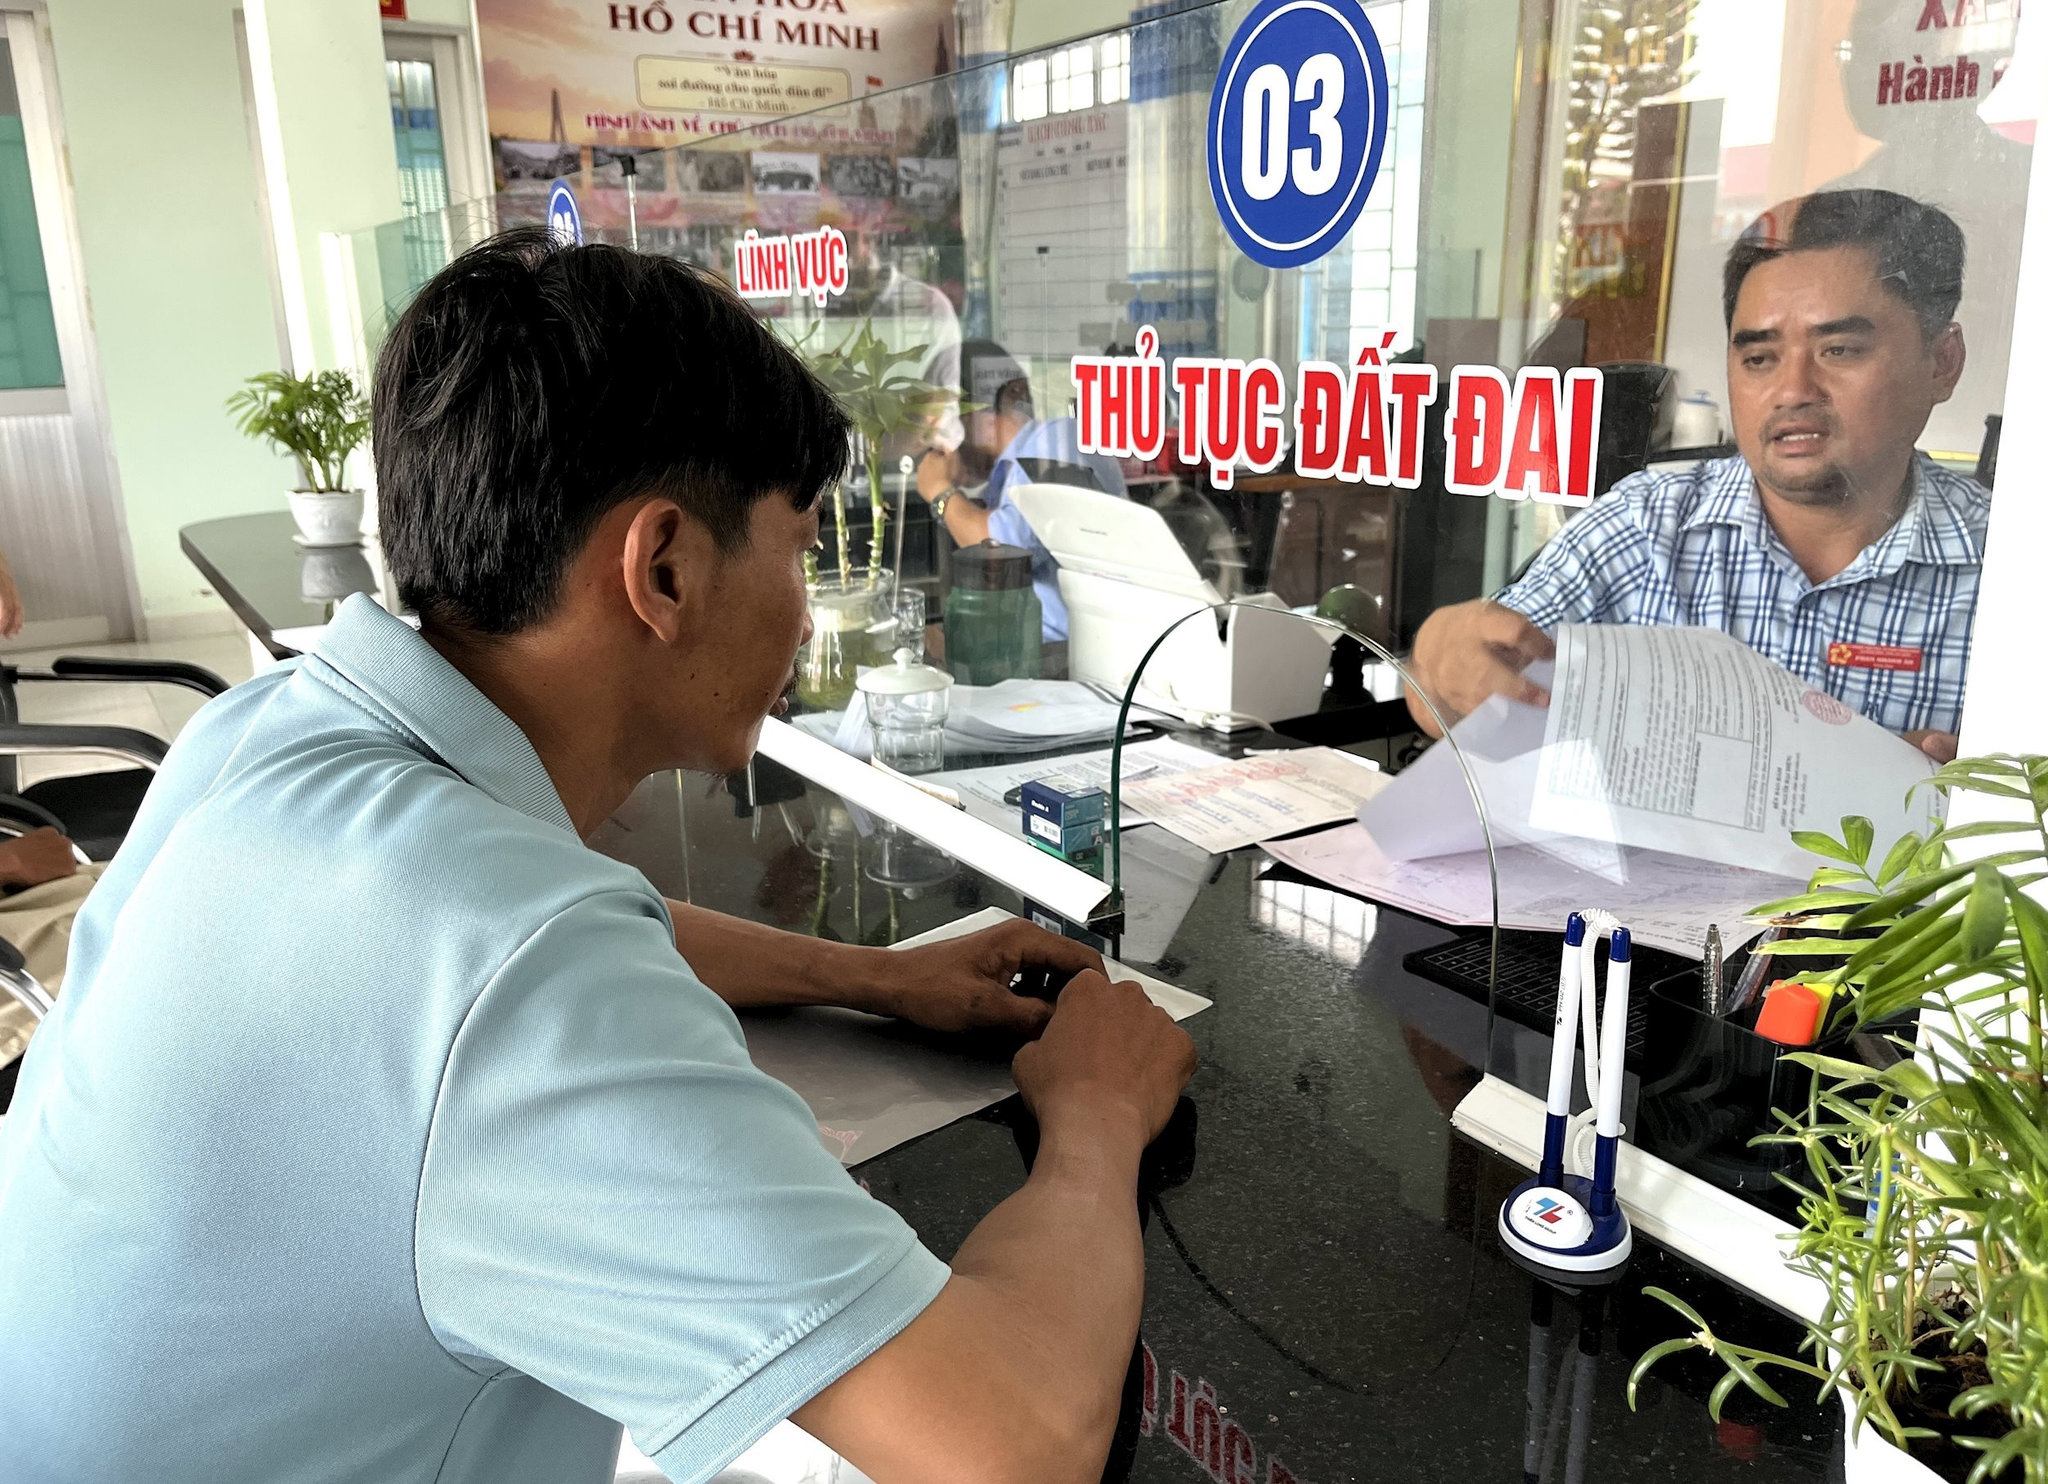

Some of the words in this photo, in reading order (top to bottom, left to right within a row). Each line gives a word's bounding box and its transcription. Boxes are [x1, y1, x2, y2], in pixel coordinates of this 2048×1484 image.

[608, 1, 675, 34] HỒ
[688, 10, 764, 42] CHÍ
[776, 19, 880, 51] MINH
[1877, 54, 1980, 105] Hành
[1241, 52, 1345, 201] 03
[736, 233, 790, 294] LĨNH
[794, 229, 846, 303] VỰC
[1073, 329, 1160, 453] THỦ
[1175, 365, 1281, 484] TỤC
[1298, 330, 1433, 481] ĐẤT
[1450, 374, 1598, 499] ĐAI
